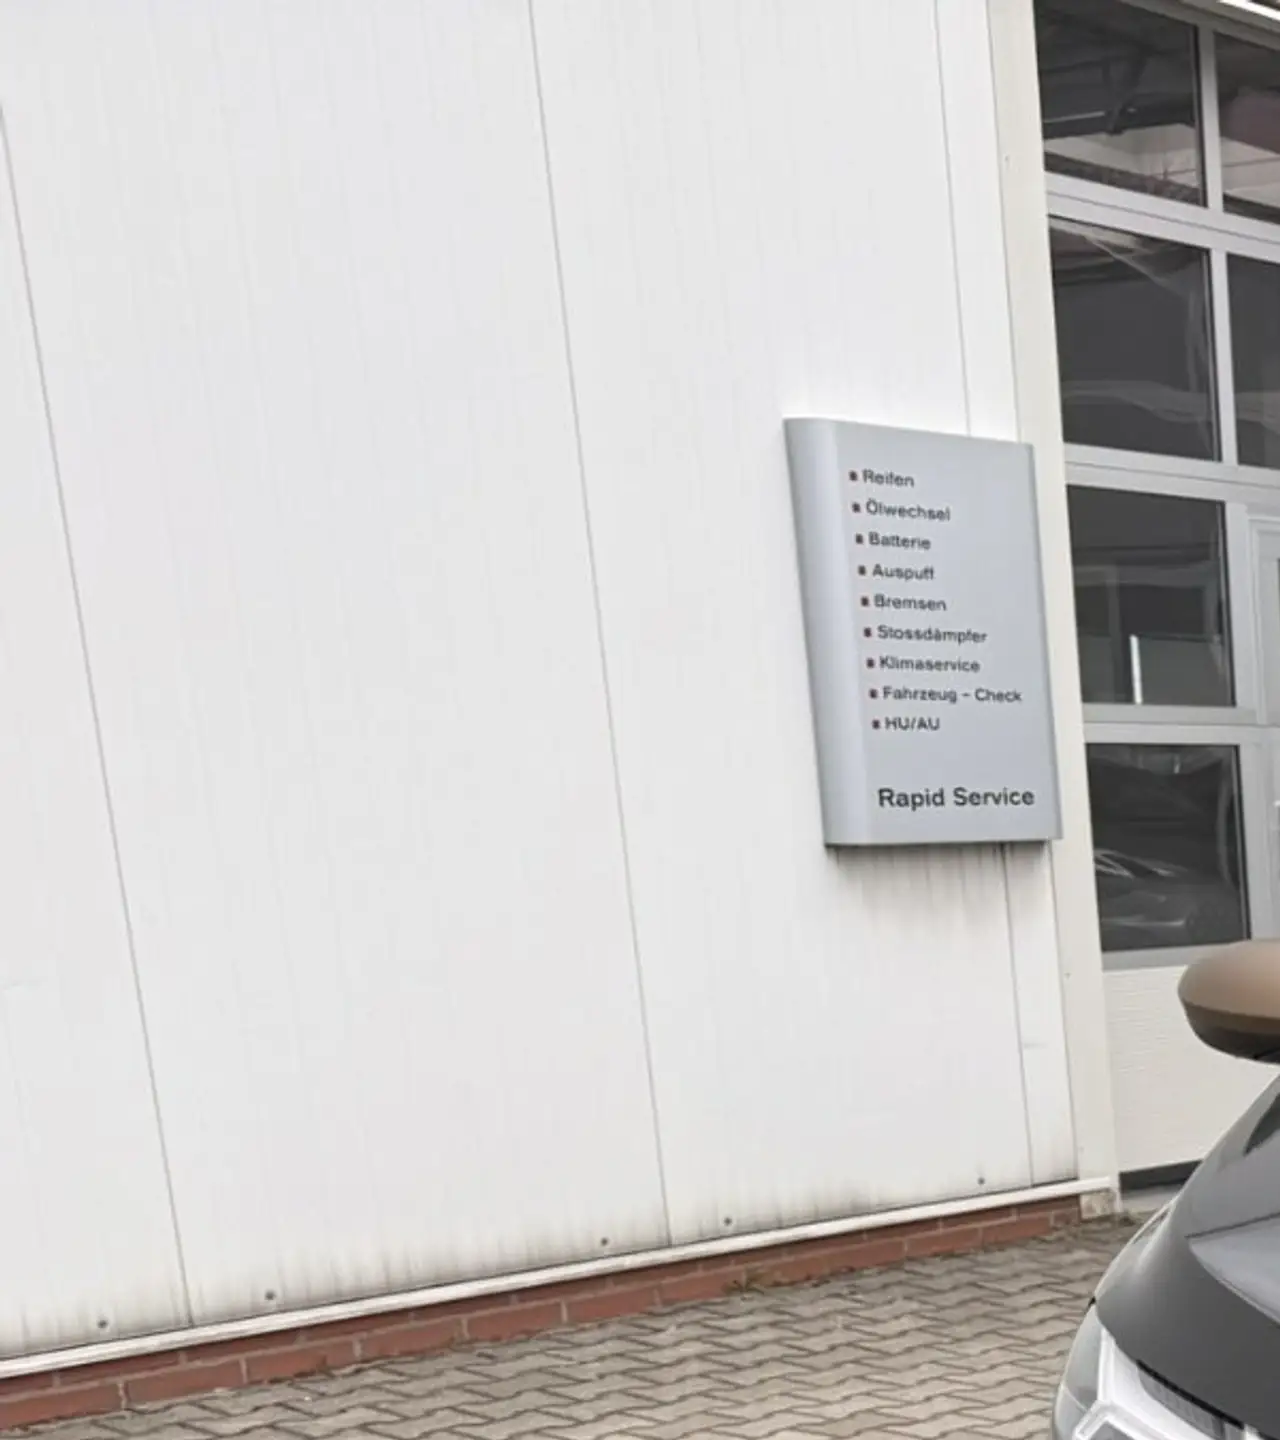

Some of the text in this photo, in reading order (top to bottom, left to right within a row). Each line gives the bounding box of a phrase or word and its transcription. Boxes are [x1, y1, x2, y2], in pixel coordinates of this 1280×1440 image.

[862, 468, 915, 488] Reifen
[866, 499, 950, 522] Ölwechsel
[868, 531, 931, 551] Batterie
[872, 563, 935, 581] Auspuff
[874, 594, 947, 612] Bremsen
[877, 625, 988, 645] Stossdämpfer
[879, 655, 981, 674] Klimaservice
[882, 686, 957, 705] Fahrzeug
[974, 687, 1022, 704] Check
[884, 716, 940, 732] HU/AU
[878, 786, 1035, 812] Rapid Service
